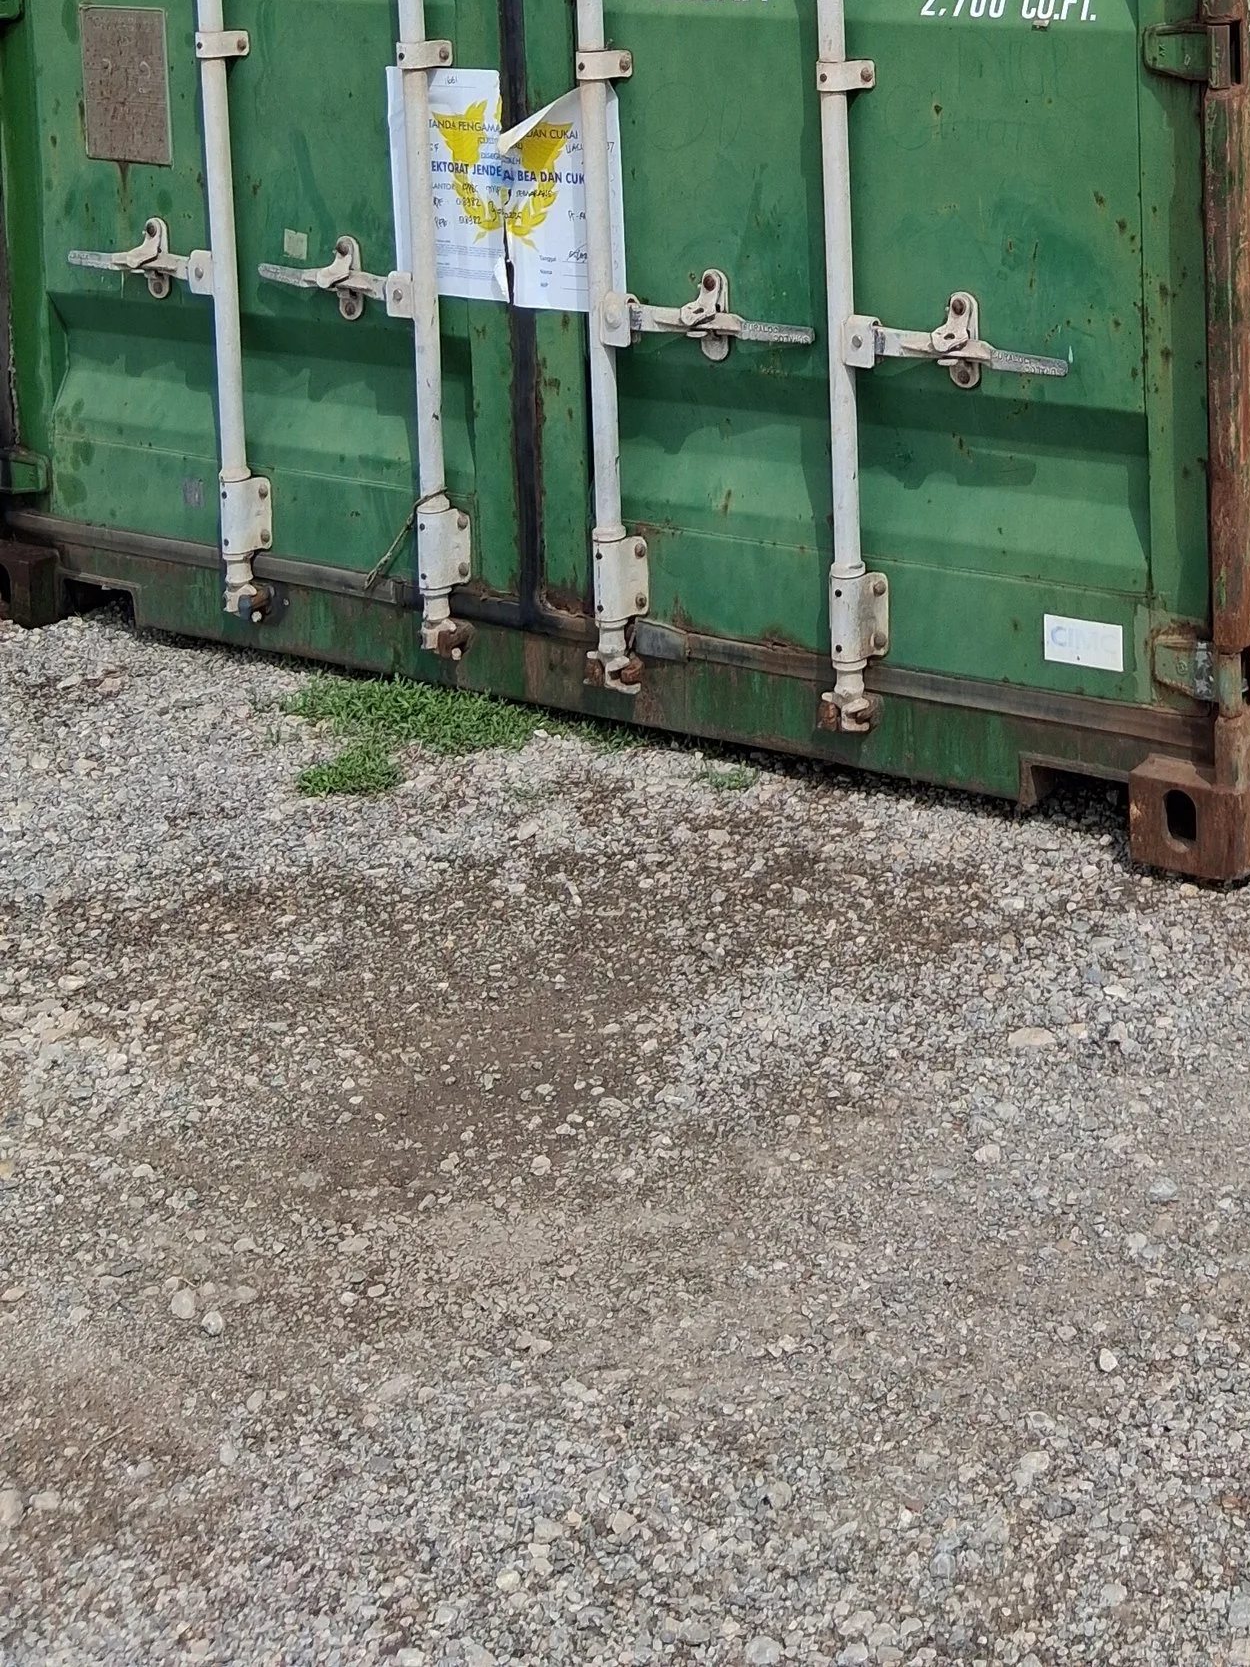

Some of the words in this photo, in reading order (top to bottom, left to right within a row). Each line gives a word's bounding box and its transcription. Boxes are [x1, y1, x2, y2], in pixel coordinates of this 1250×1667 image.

[549, 129, 579, 140] CUKAI
[431, 160, 469, 174] EKTORAT
[517, 170, 537, 182] BEA
[540, 170, 563, 183] DAN
[565, 171, 585, 184] CUK
